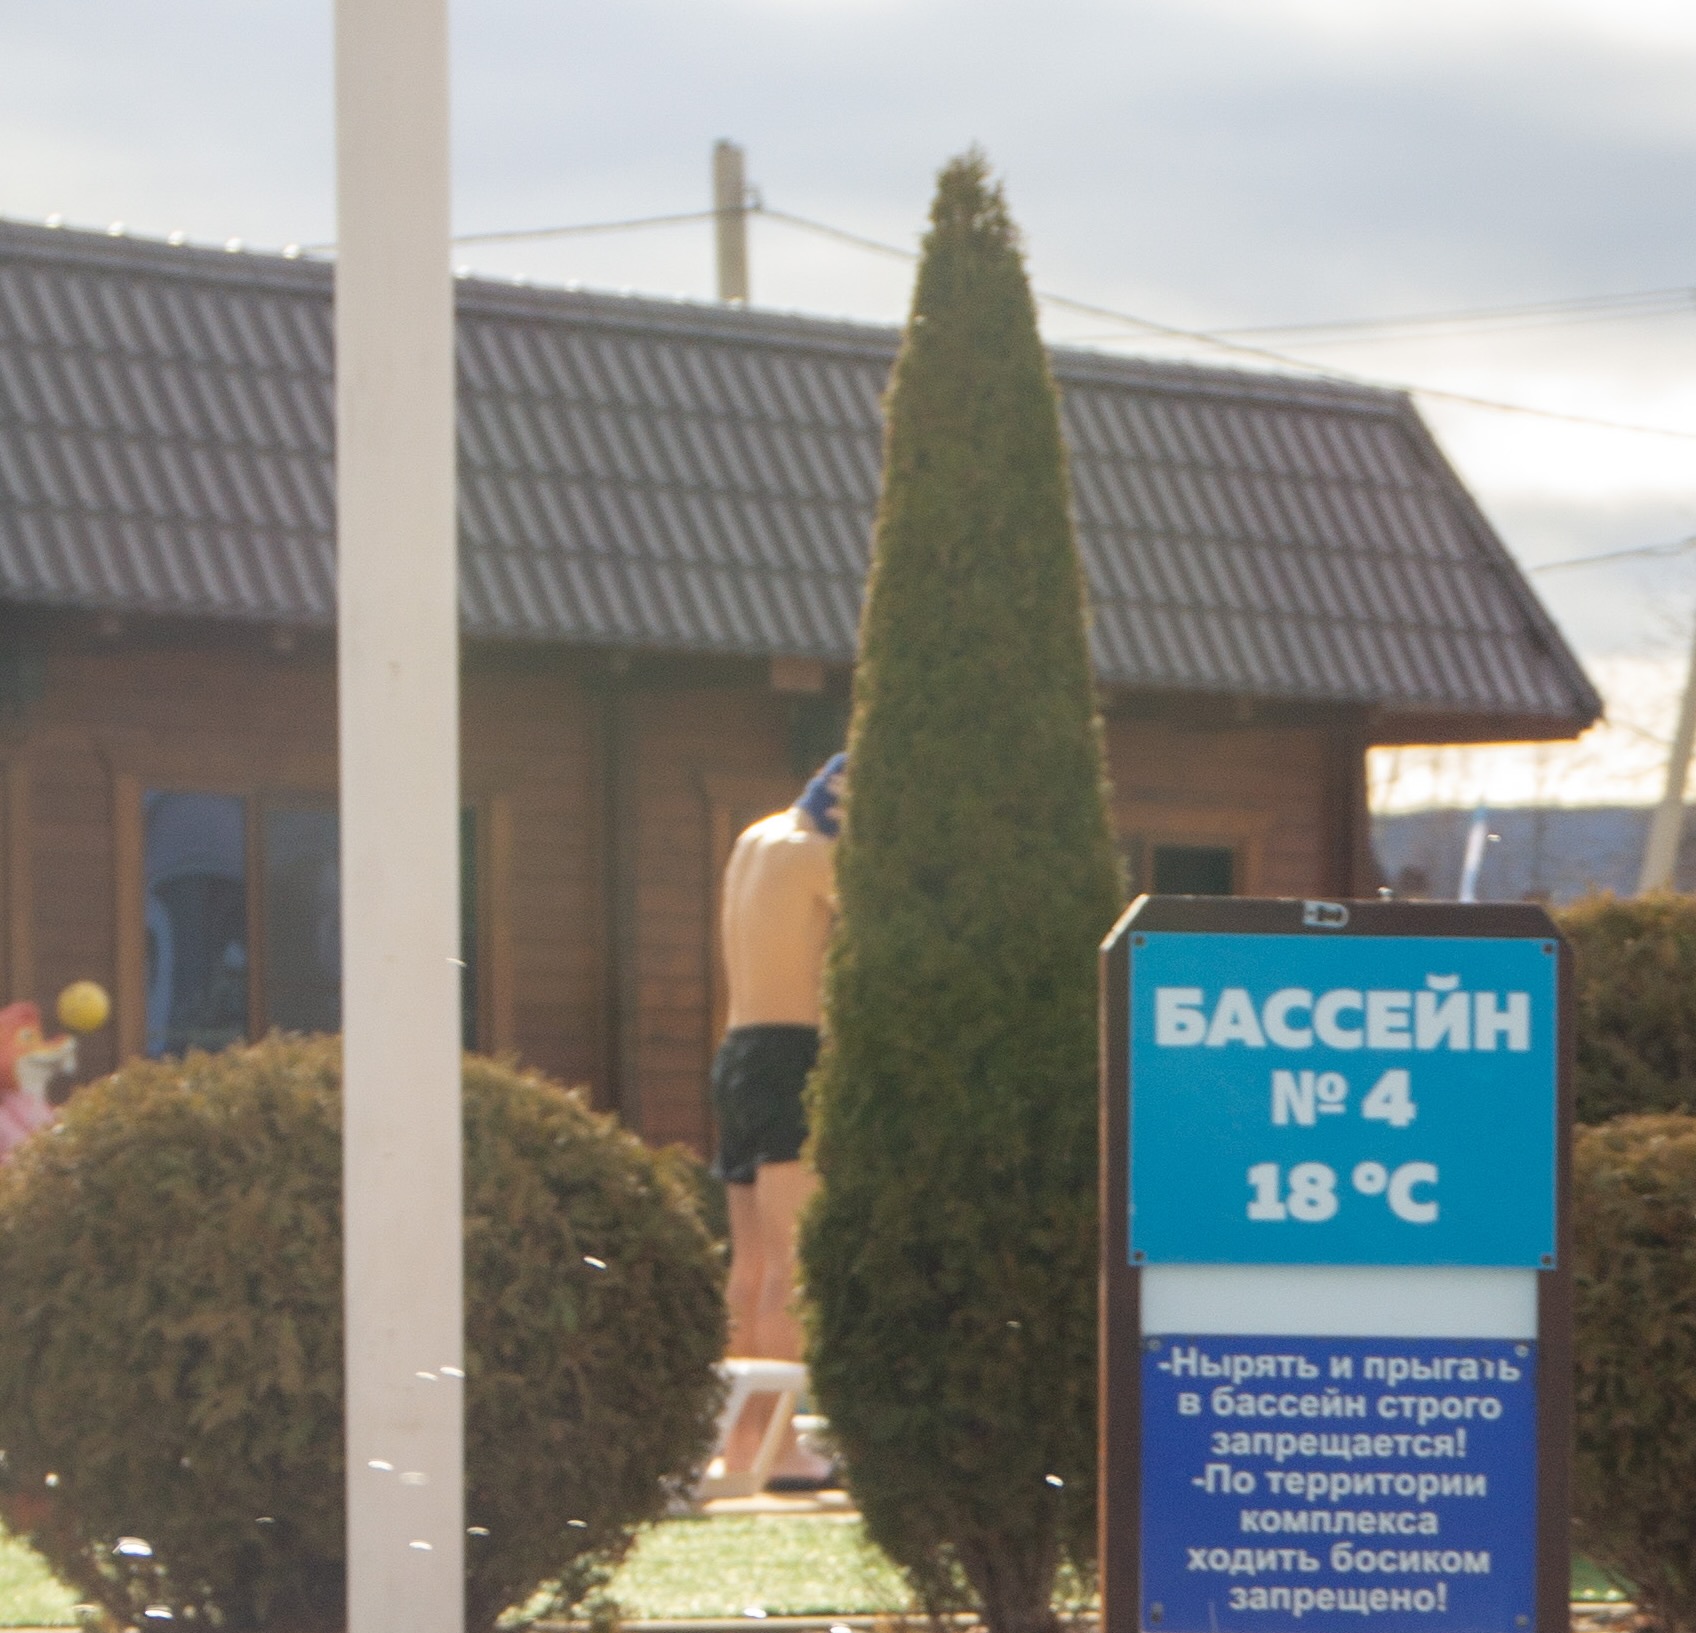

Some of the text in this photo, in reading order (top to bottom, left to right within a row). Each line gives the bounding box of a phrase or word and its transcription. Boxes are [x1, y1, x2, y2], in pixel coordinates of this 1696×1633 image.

[1154, 974, 1530, 1051] БАССЕЙН
[1271, 1069, 1416, 1127] № 4
[1247, 1162, 1338, 1222] 18
[1157, 1346, 1320, 1385] -Нырять
[1329, 1356, 1353, 1379] и
[1178, 1385, 1503, 1426] в бассейн строго
[1211, 1427, 1467, 1463] запрещается!
[1191, 1462, 1487, 1504] -По территории
[1240, 1509, 1439, 1535] комплекса
[1187, 1540, 1491, 1576] ходить босиком
[1228, 1581, 1448, 1618] запрещено!
